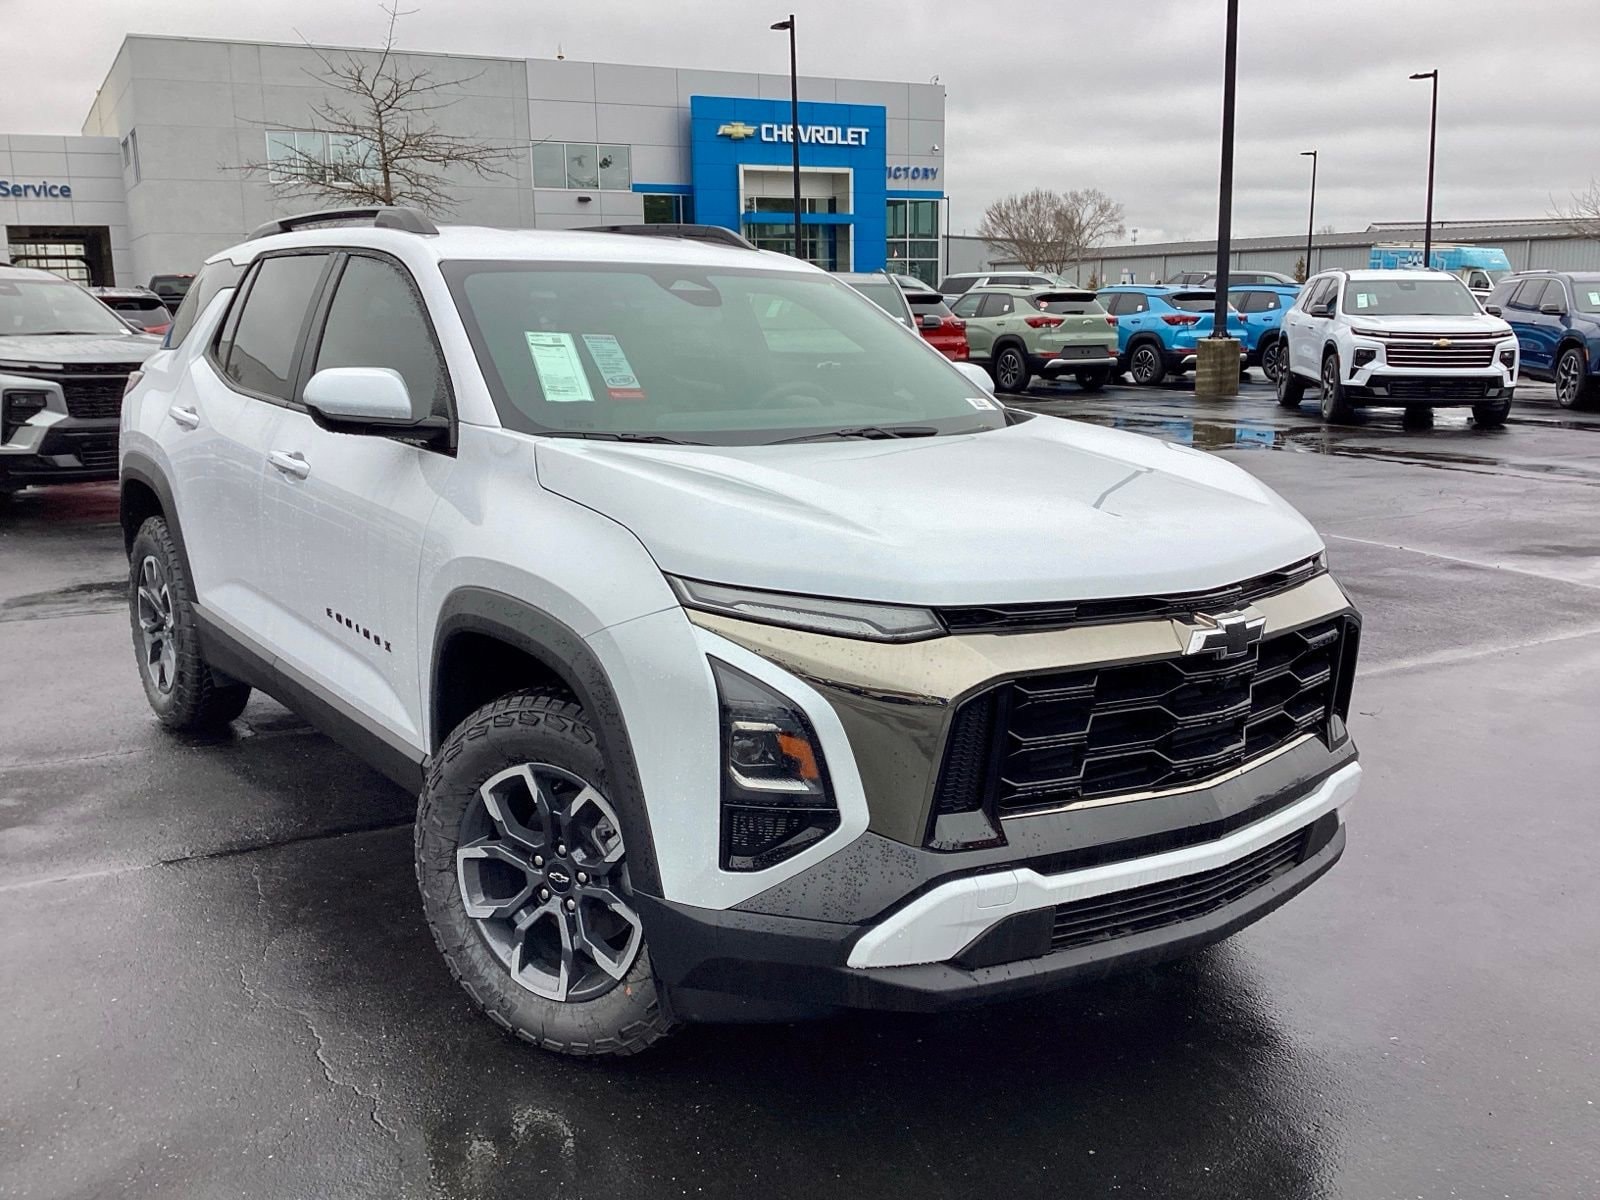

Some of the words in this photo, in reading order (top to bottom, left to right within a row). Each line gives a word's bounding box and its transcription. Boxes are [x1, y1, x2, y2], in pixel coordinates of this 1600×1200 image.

[761, 124, 869, 145] CHEVROLET
[886, 166, 939, 180] ICTORY
[0, 180, 72, 198] Service
